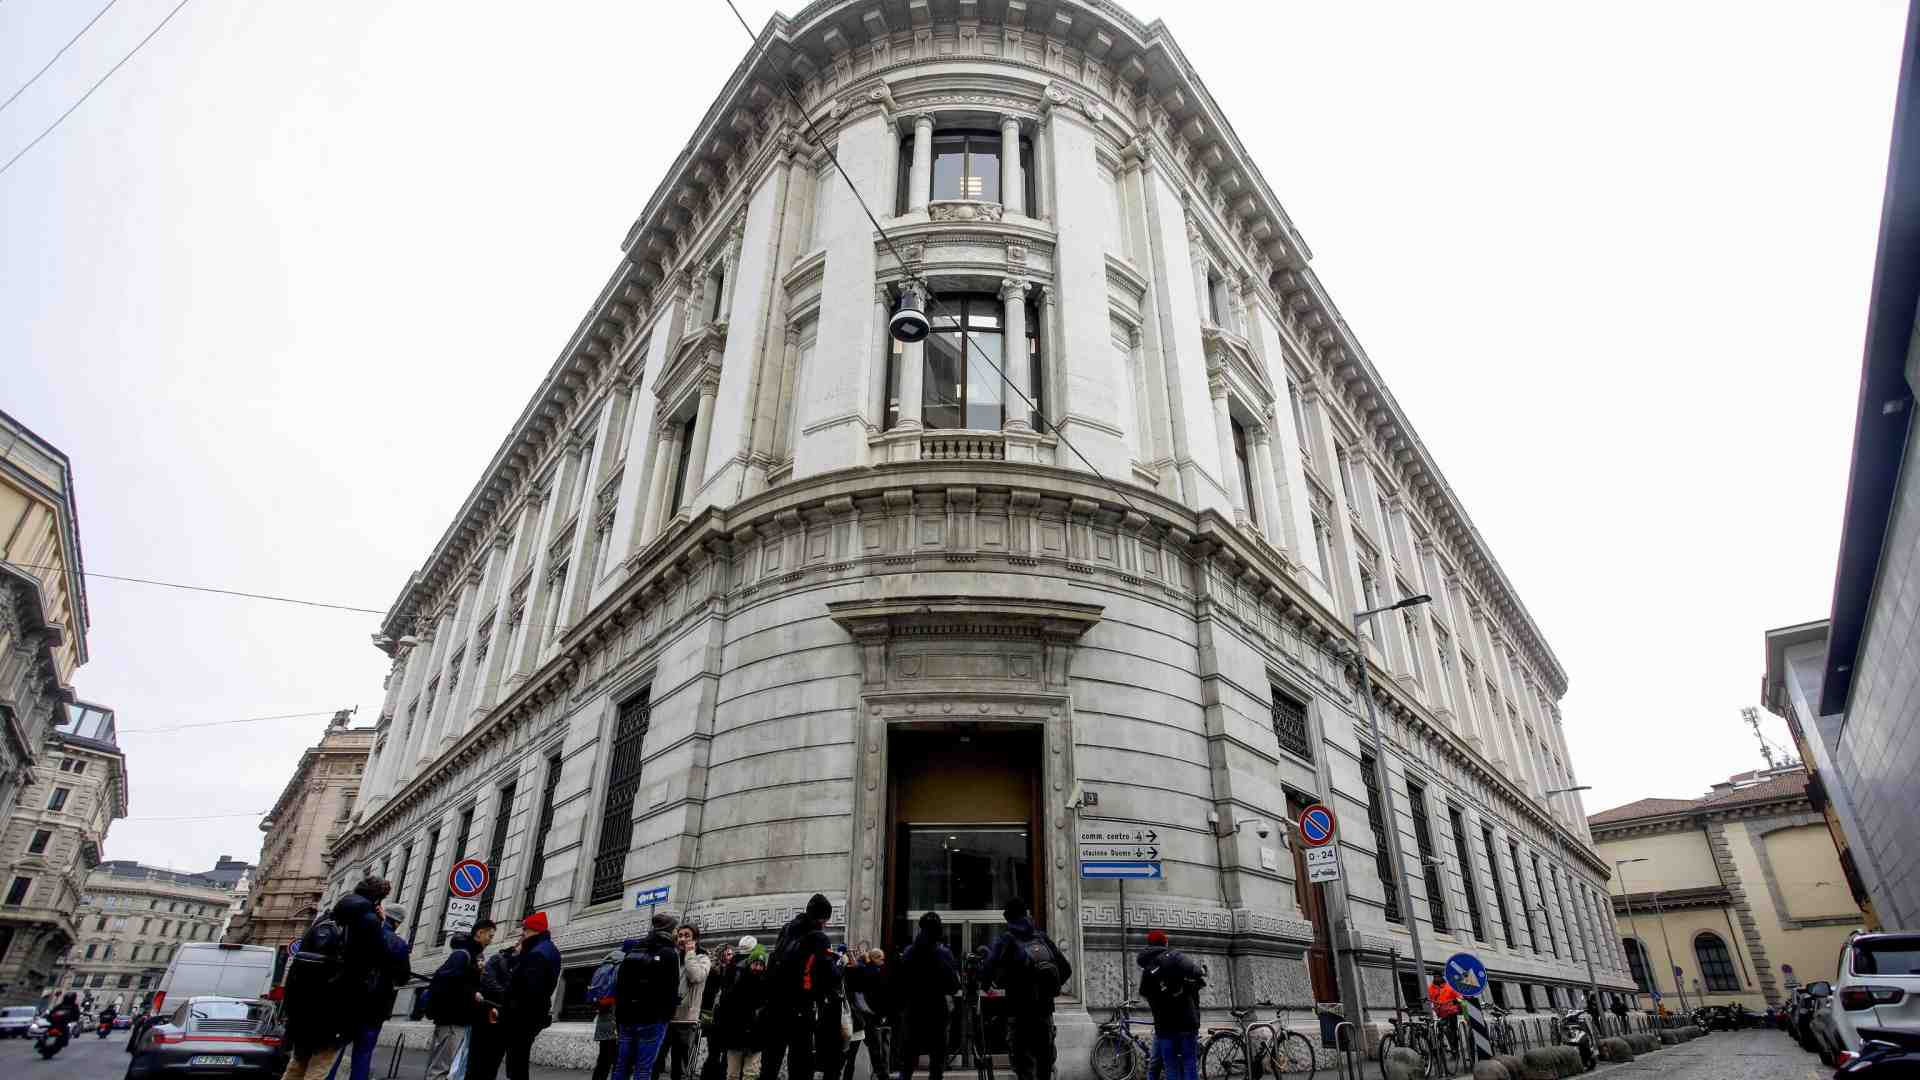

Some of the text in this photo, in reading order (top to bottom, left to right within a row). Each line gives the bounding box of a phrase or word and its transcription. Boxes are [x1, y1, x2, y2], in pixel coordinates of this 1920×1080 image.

[1107, 832, 1130, 840] centro
[1321, 849, 1333, 859] 24
[451, 902, 458, 910] 0
[464, 903, 476, 912] 24
